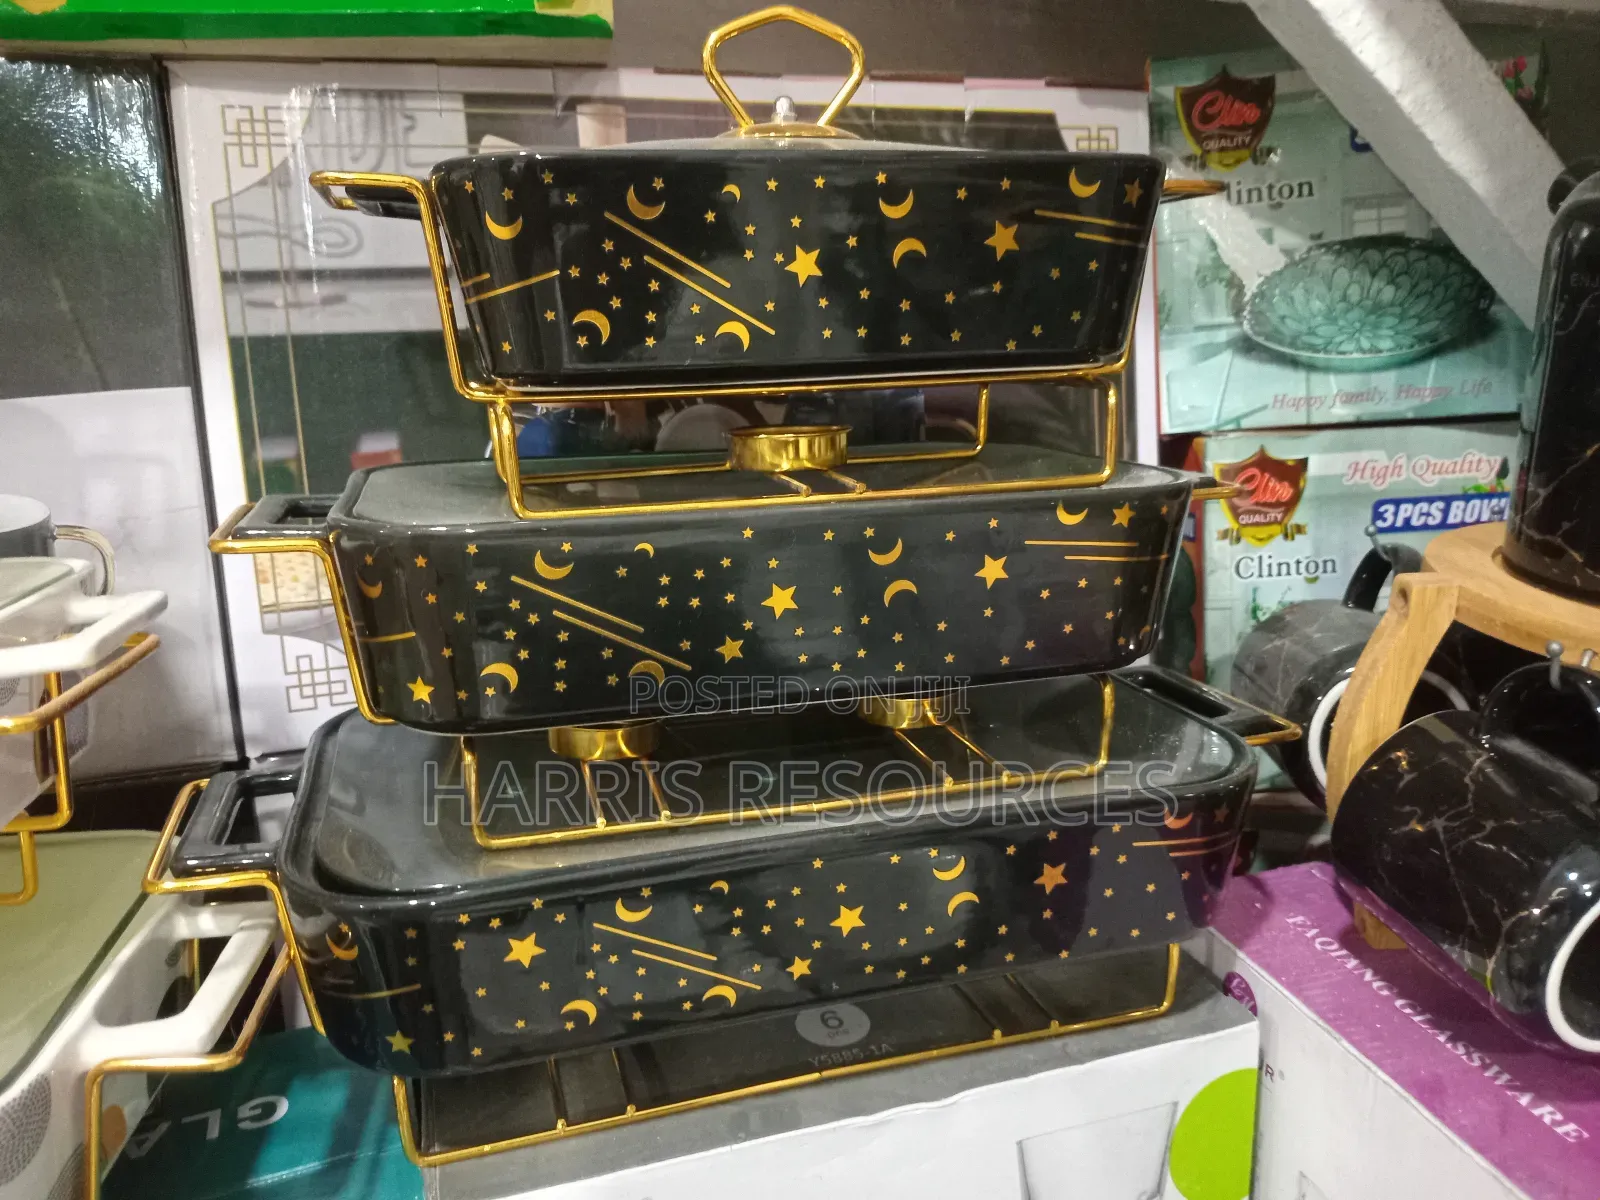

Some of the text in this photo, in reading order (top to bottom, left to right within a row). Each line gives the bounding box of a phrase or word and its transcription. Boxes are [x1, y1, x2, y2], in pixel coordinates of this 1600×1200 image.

[1203, 135, 1251, 151] QUALITY
[1224, 180, 1315, 205] linton
[1271, 393, 1327, 412] Happy
[1394, 383, 1453, 403] Happy
[1459, 376, 1493, 398] Life
[1346, 451, 1502, 487] High Quality
[1238, 512, 1283, 525] QUALITY
[1375, 500, 1446, 528] 3PCS
[1234, 554, 1338, 581] Clinton
[820, 1010, 844, 1029] 6
[1394, 998, 1590, 1143] GLASSWARE
